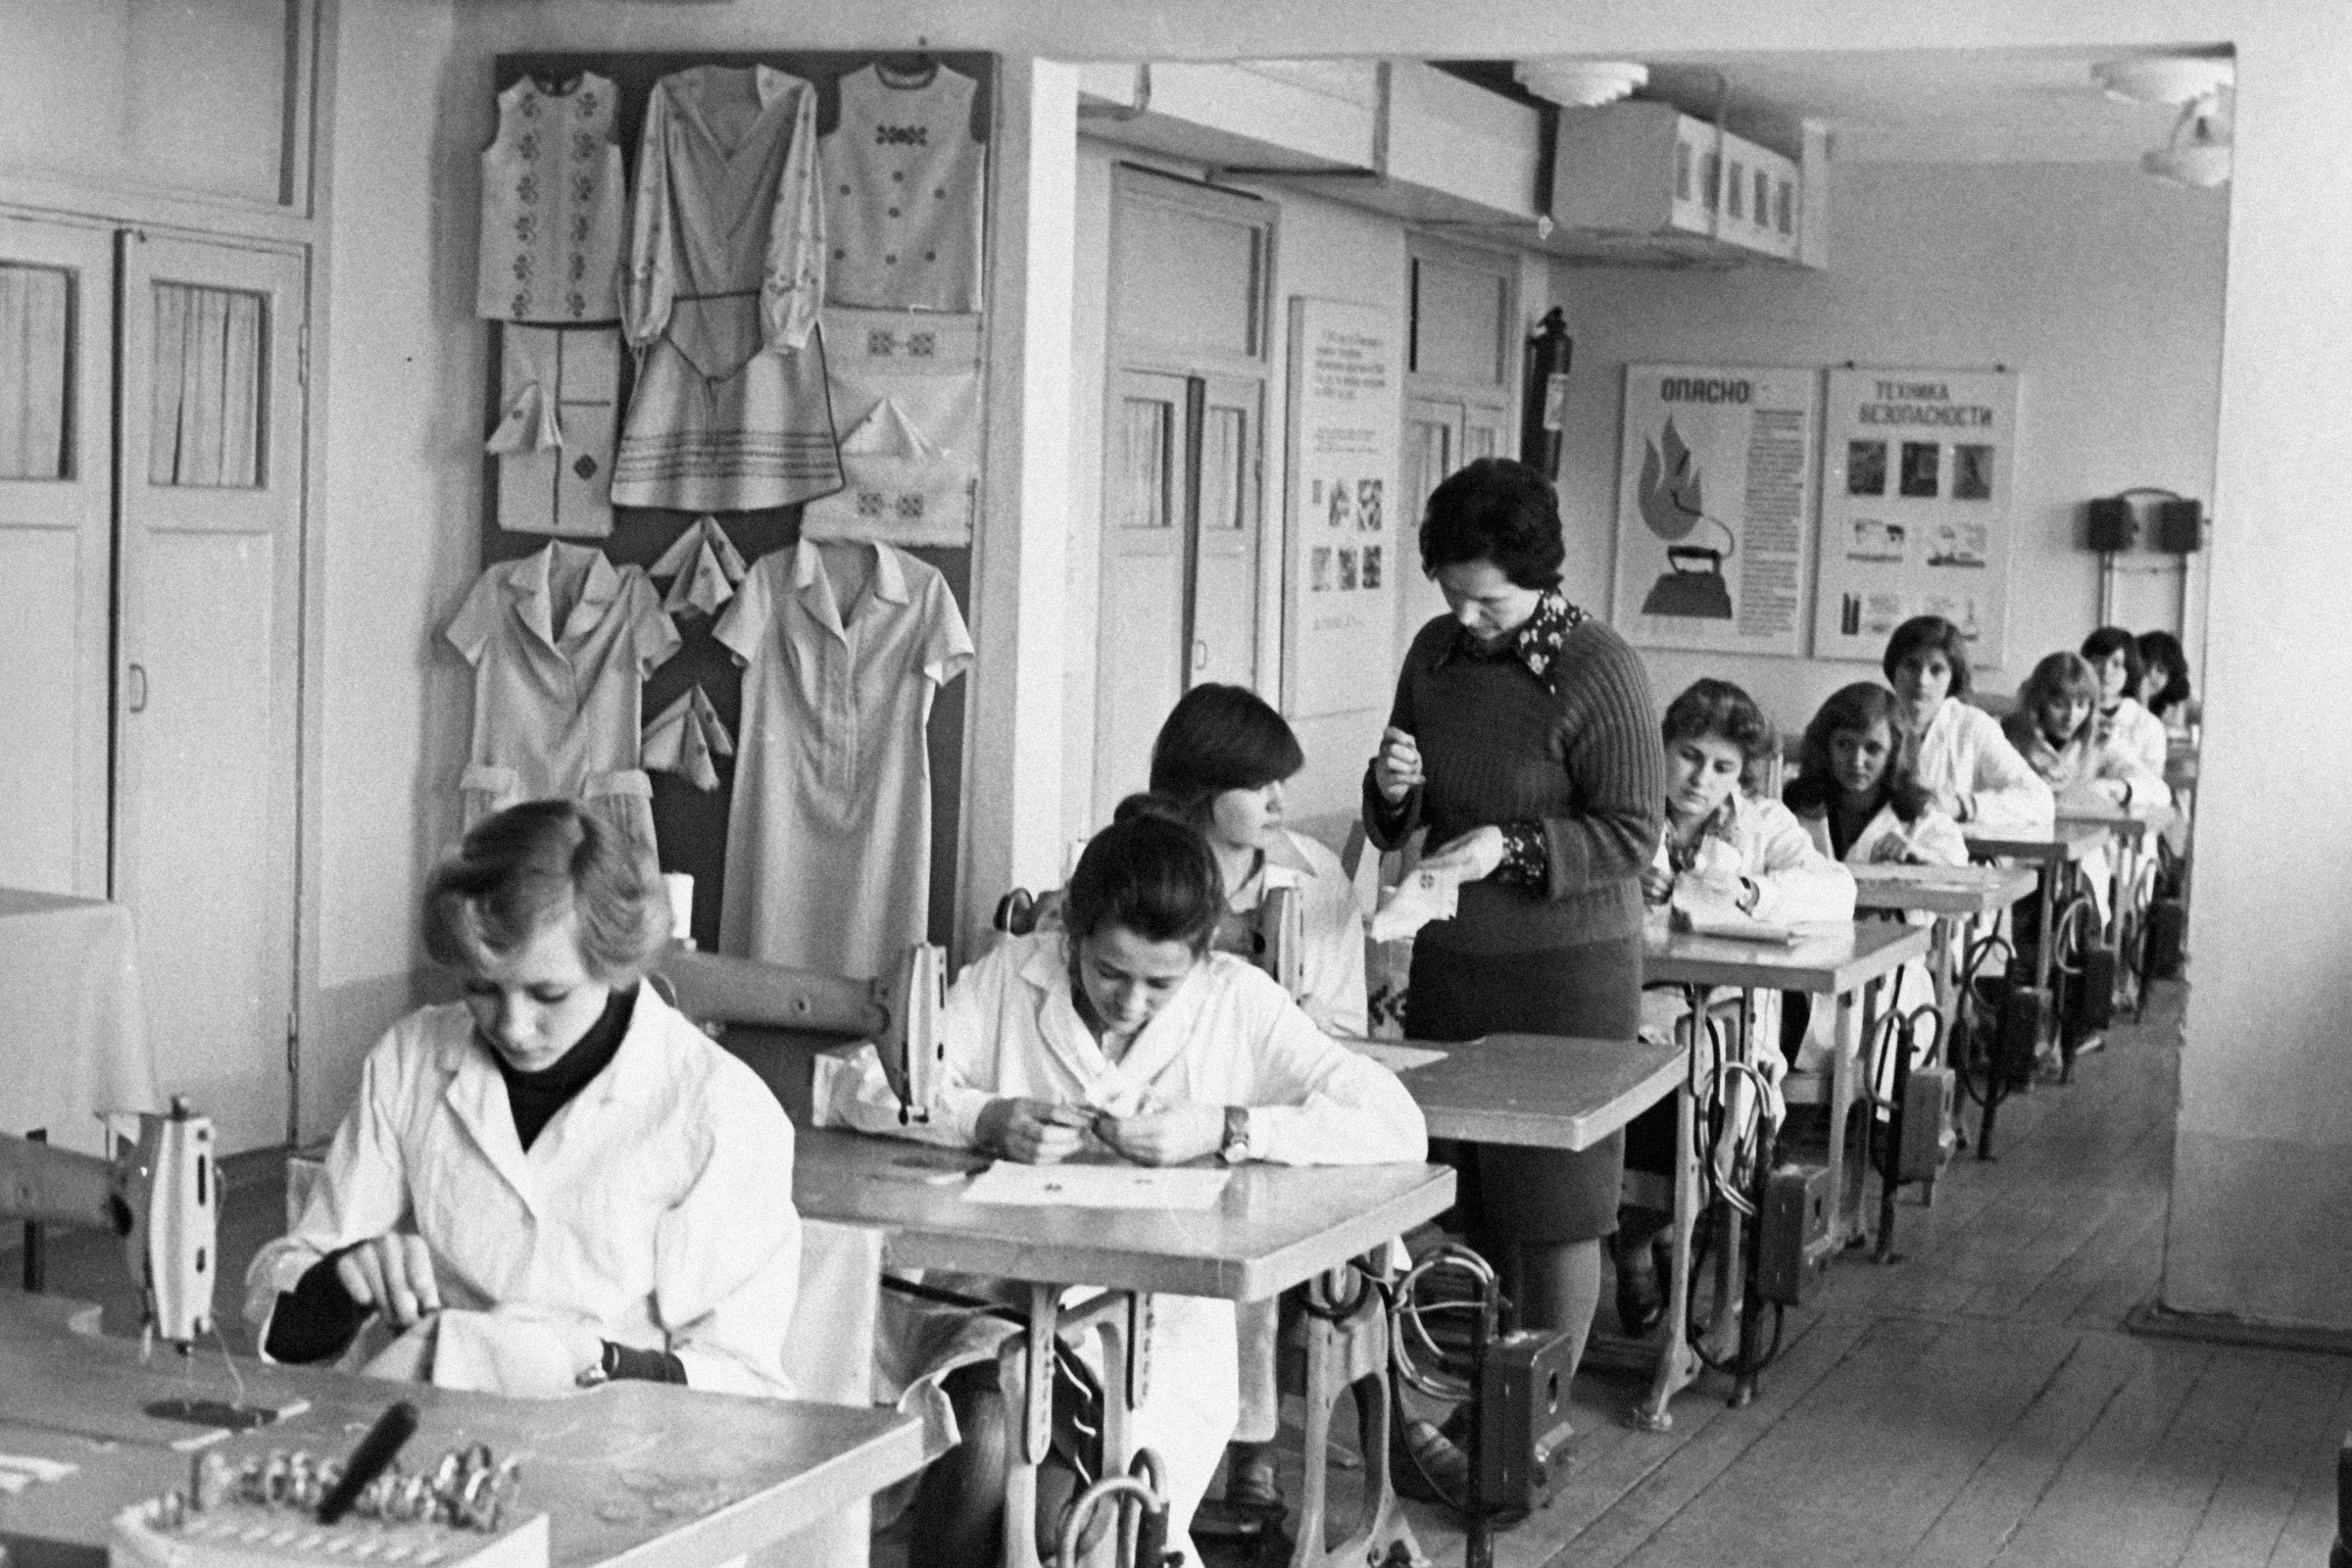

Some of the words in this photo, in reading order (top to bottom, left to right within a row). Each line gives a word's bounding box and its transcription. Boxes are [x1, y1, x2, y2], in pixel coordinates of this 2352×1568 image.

[1661, 377, 1749, 404] ОПАСНО
[1876, 380, 1949, 401] ТЕХНИКА
[1859, 403, 1993, 427] БЕЗОПАСНОСТИ
